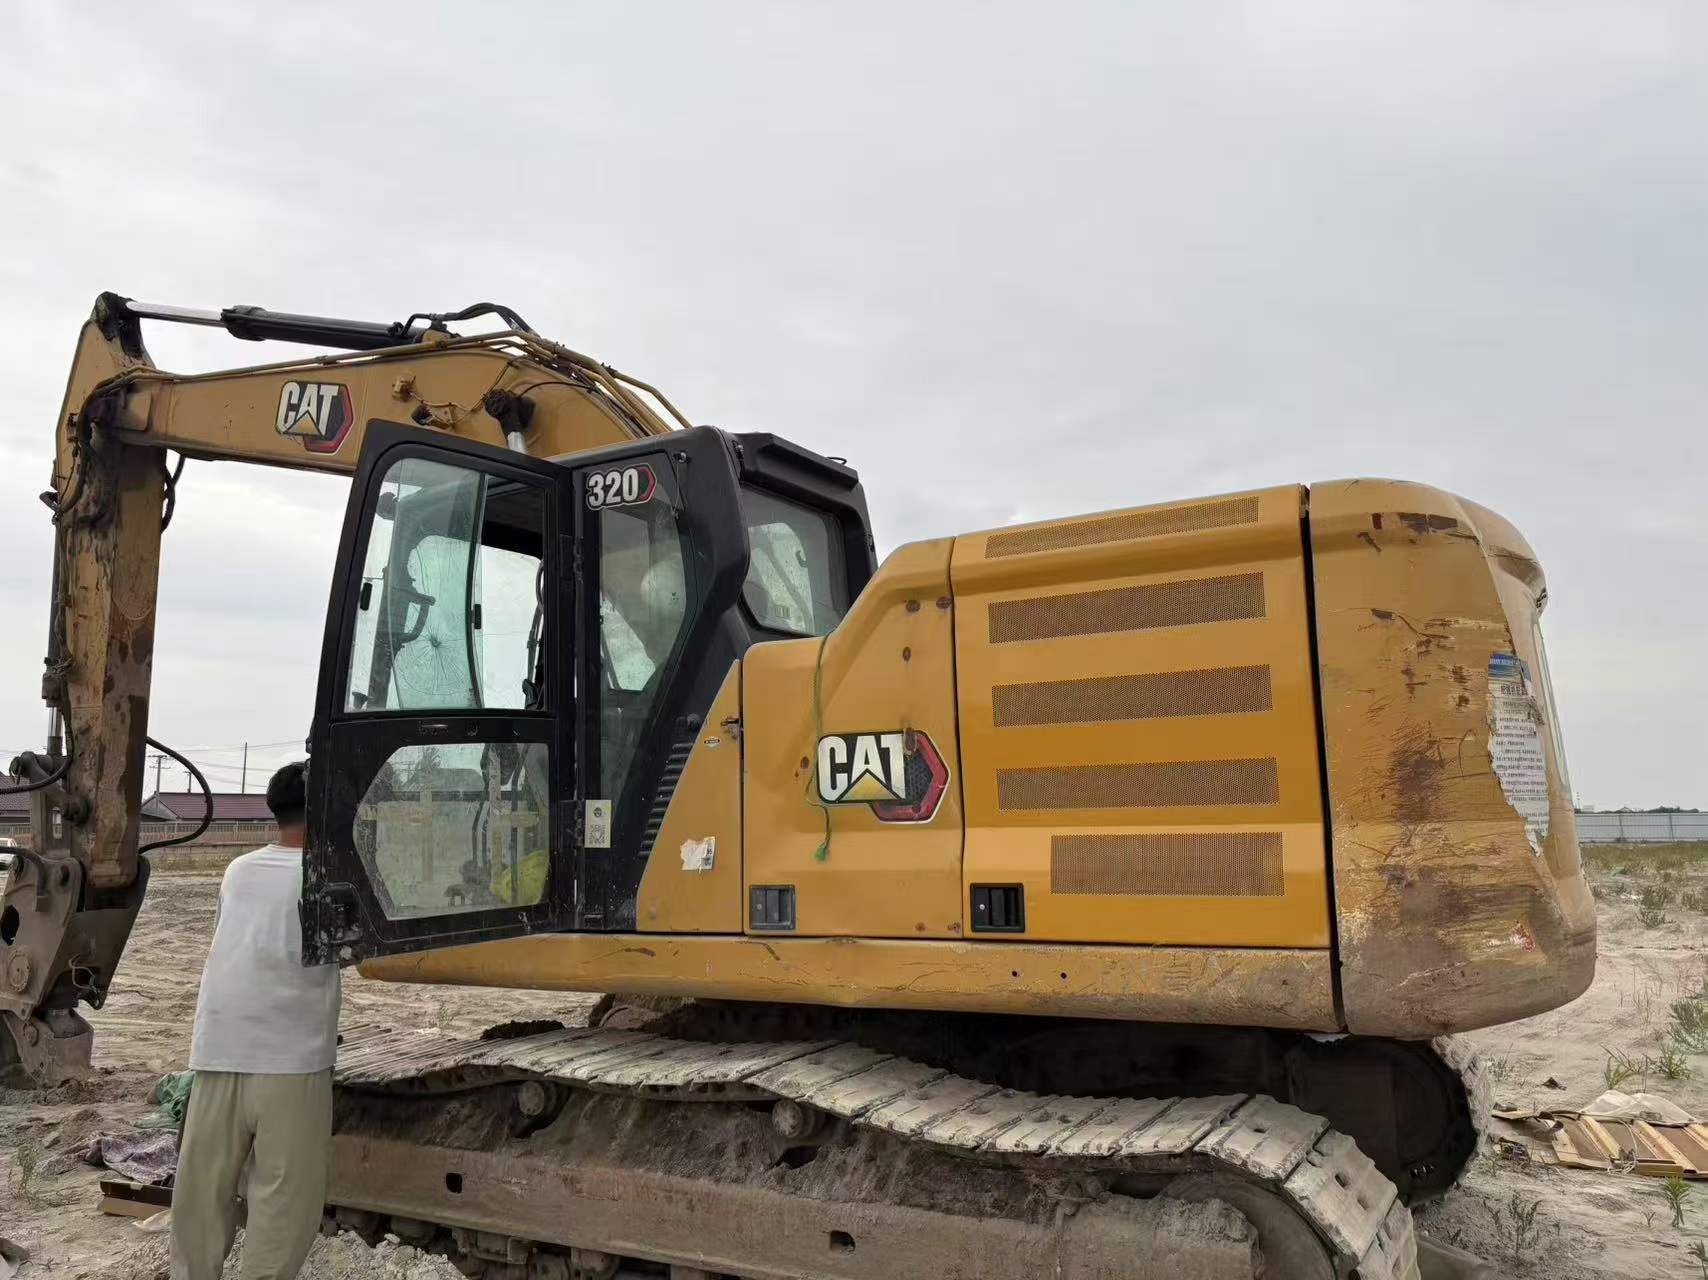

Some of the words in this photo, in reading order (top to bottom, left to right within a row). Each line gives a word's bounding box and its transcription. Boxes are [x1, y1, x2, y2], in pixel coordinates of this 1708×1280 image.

[276, 381, 340, 436] CAT
[588, 468, 639, 507] 320
[818, 733, 906, 802] CAT
